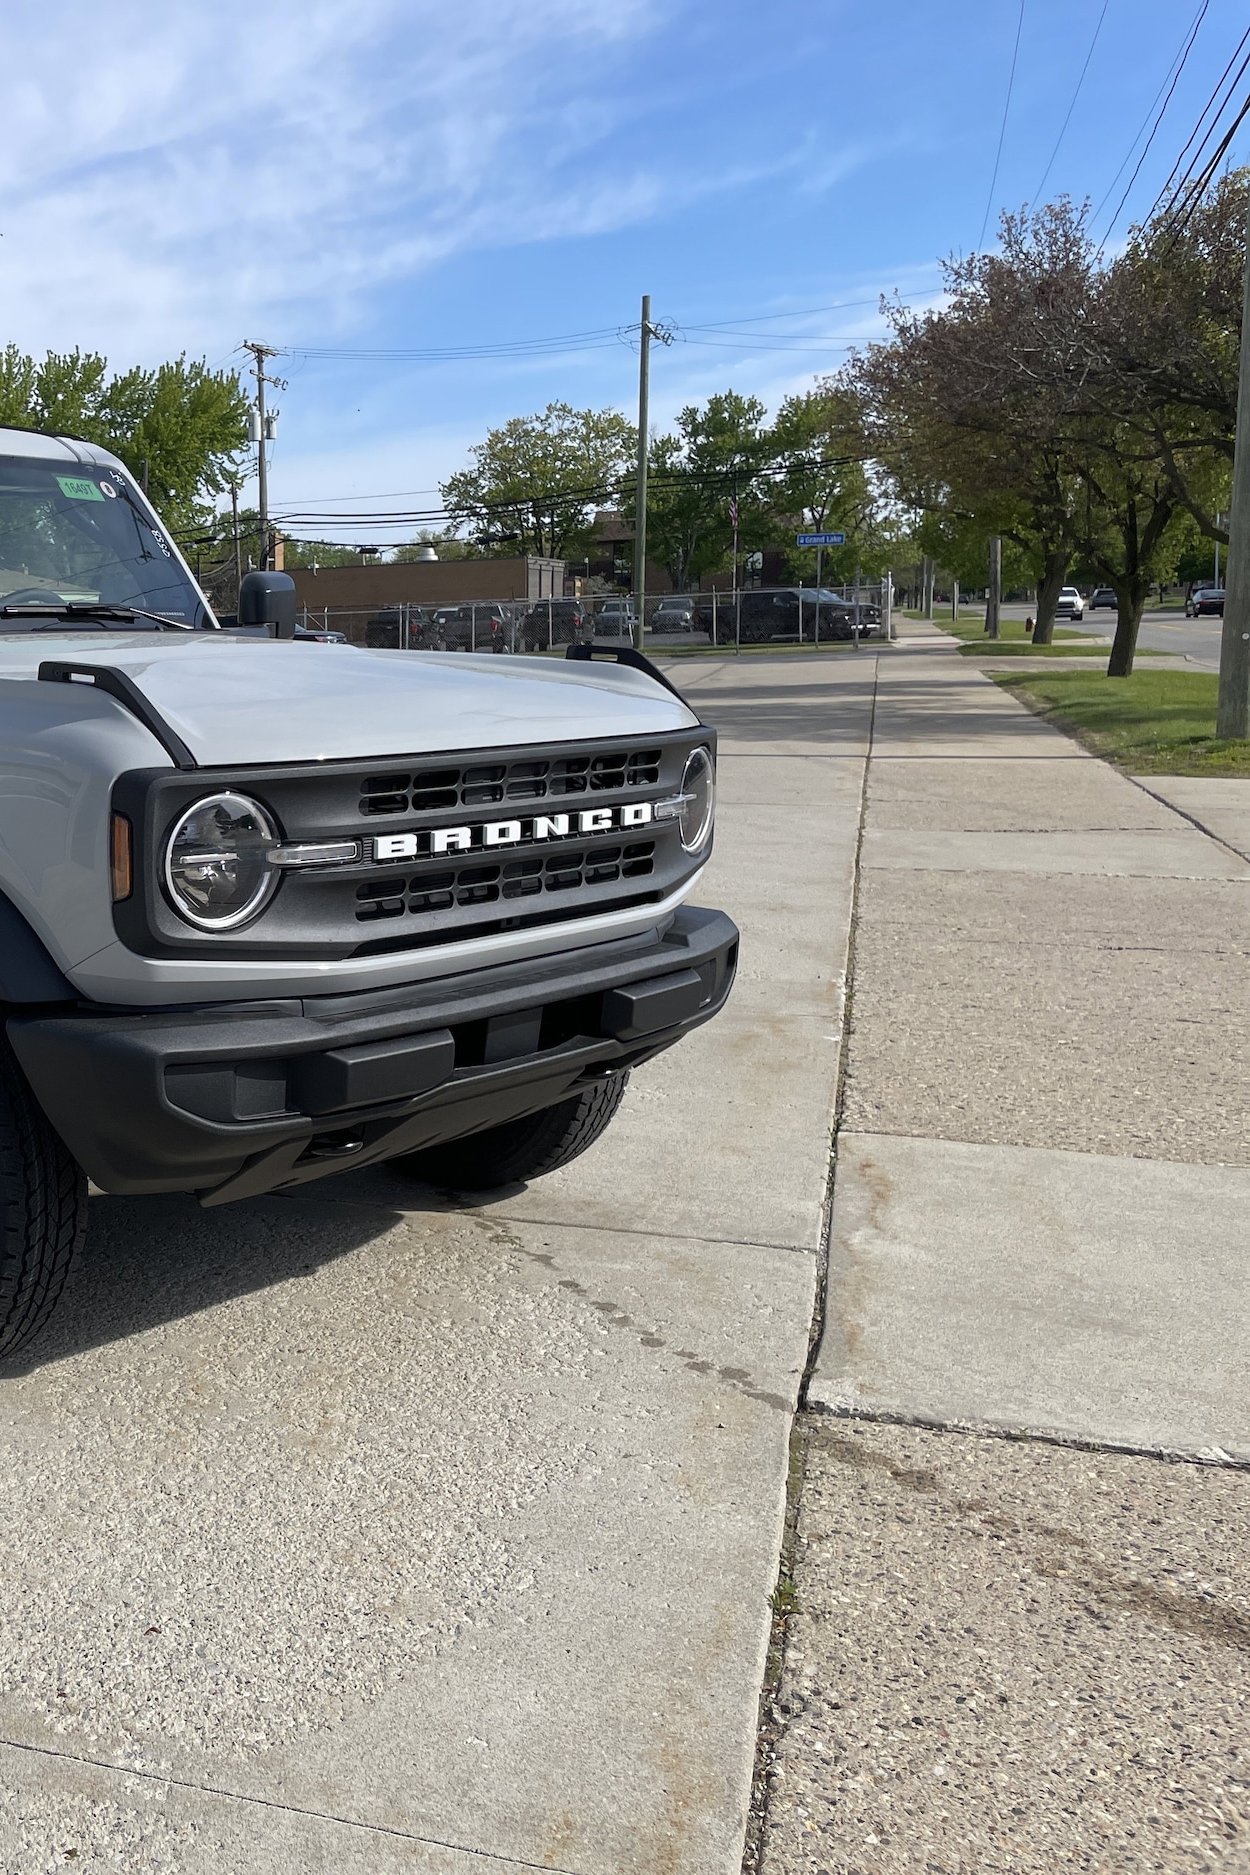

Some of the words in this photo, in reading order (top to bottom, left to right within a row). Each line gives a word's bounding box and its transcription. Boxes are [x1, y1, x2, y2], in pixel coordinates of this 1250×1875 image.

[805, 536, 826, 545] Grand
[827, 535, 843, 544] Lake
[373, 802, 652, 860] BRONCO
